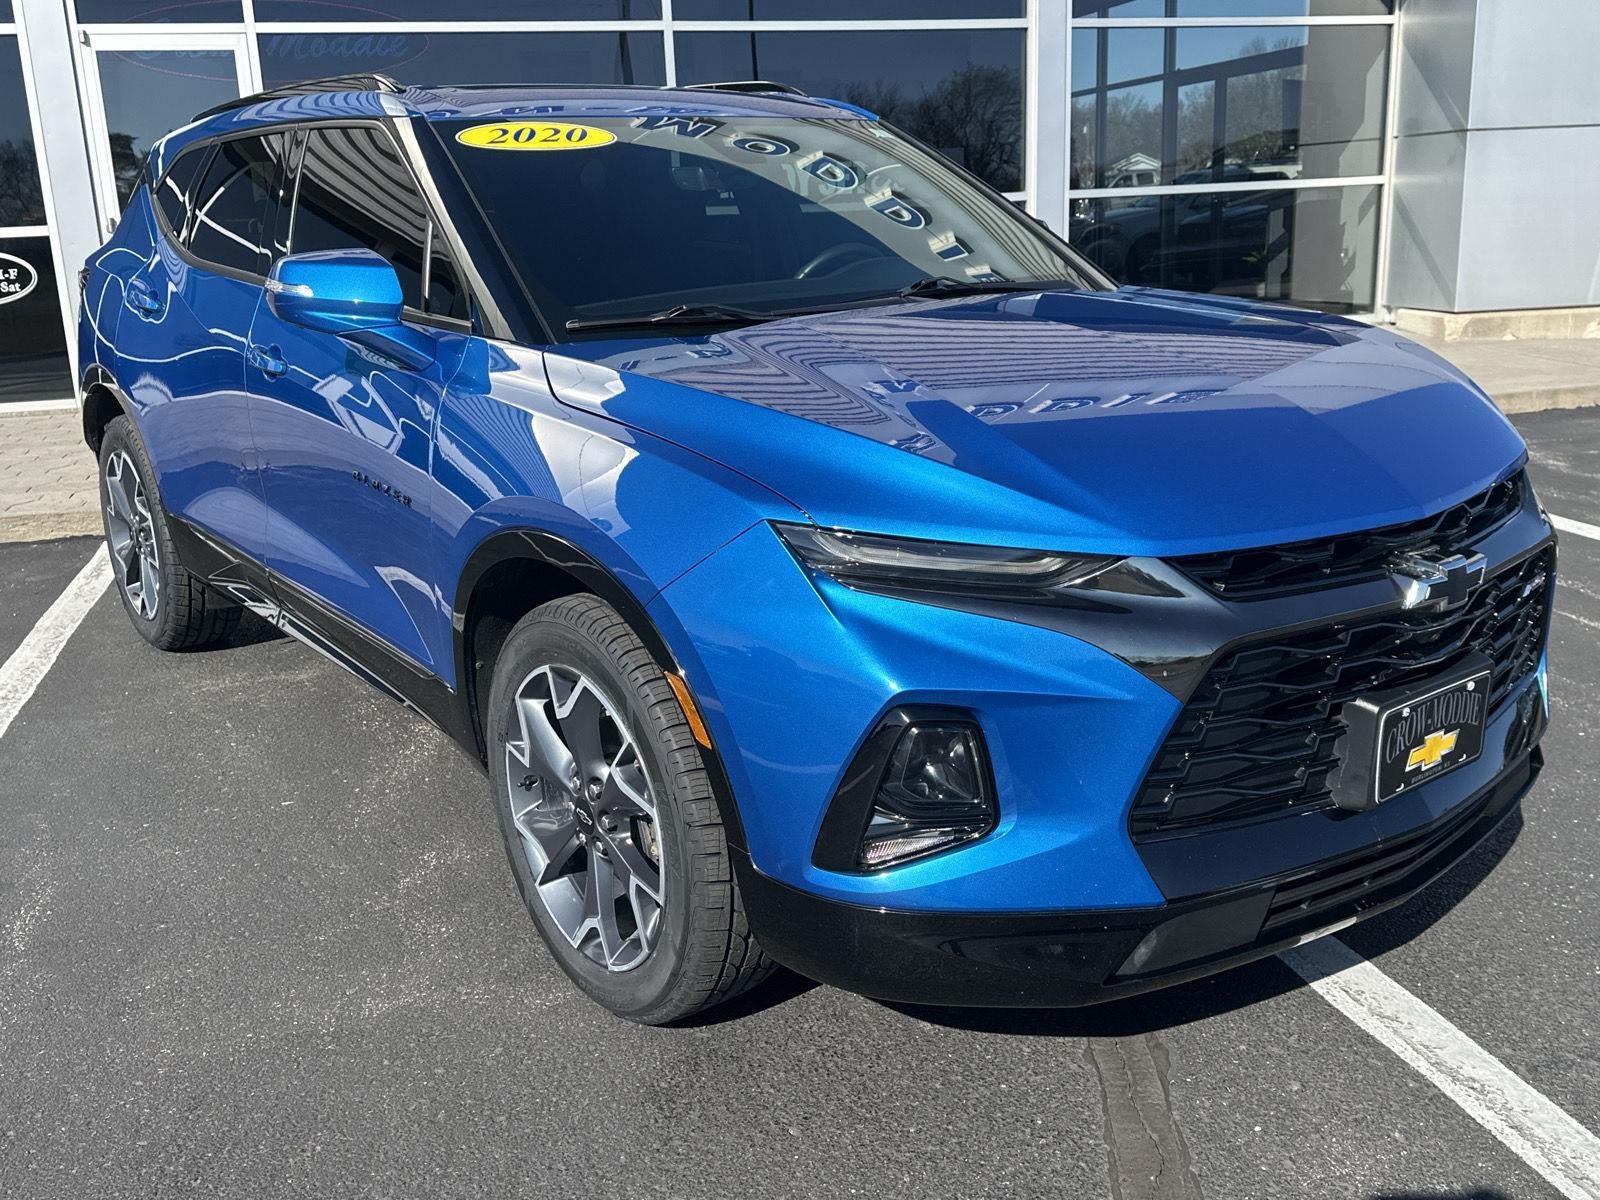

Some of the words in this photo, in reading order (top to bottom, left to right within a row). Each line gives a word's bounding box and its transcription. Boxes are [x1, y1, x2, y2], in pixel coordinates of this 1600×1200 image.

[486, 126, 588, 145] 2020
[0, 281, 21, 292] Sat
[1386, 691, 1482, 764] CROW-MODDIE
